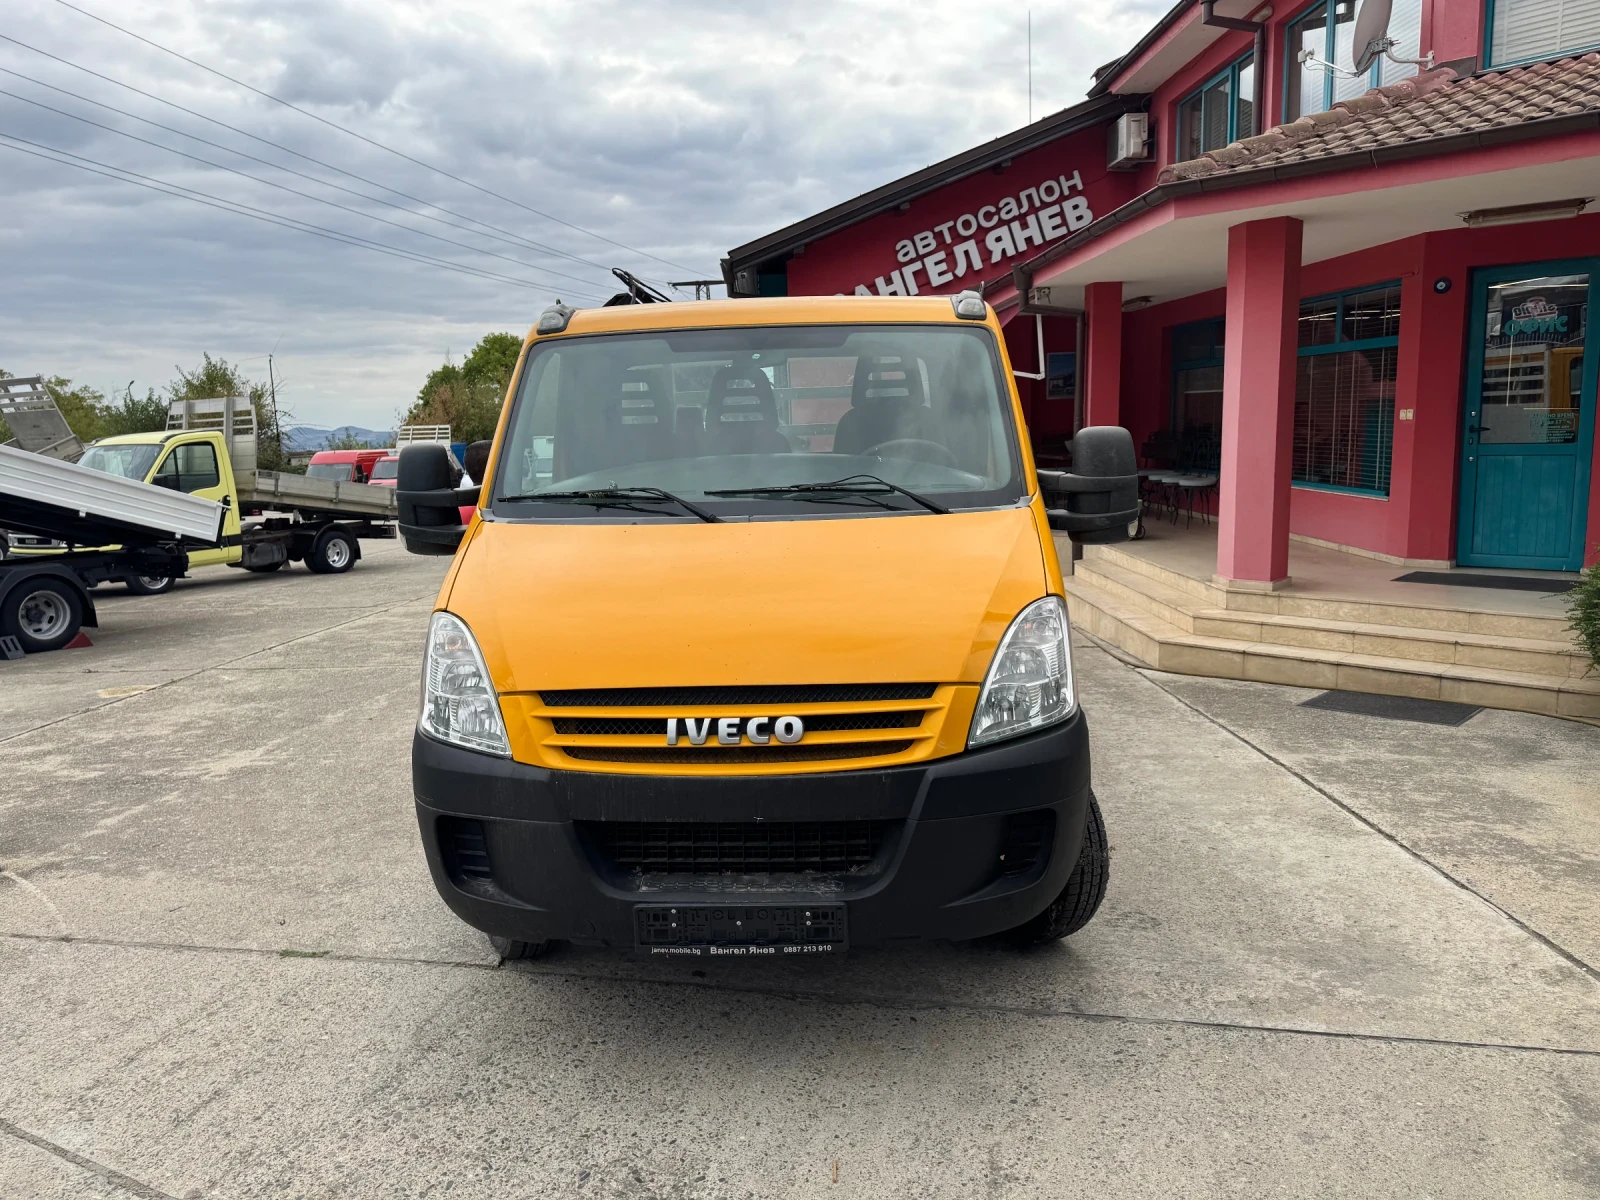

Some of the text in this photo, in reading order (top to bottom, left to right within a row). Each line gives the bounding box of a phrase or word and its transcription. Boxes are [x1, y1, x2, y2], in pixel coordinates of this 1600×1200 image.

[833, 195, 1094, 297] НГЕЛ ЯНЕВ
[895, 170, 1084, 263] автосалон
[666, 715, 804, 745] IVECO
[710, 946, 746, 955] Вангел
[749, 946, 775, 954] Янев
[818, 944, 832, 952] 910
